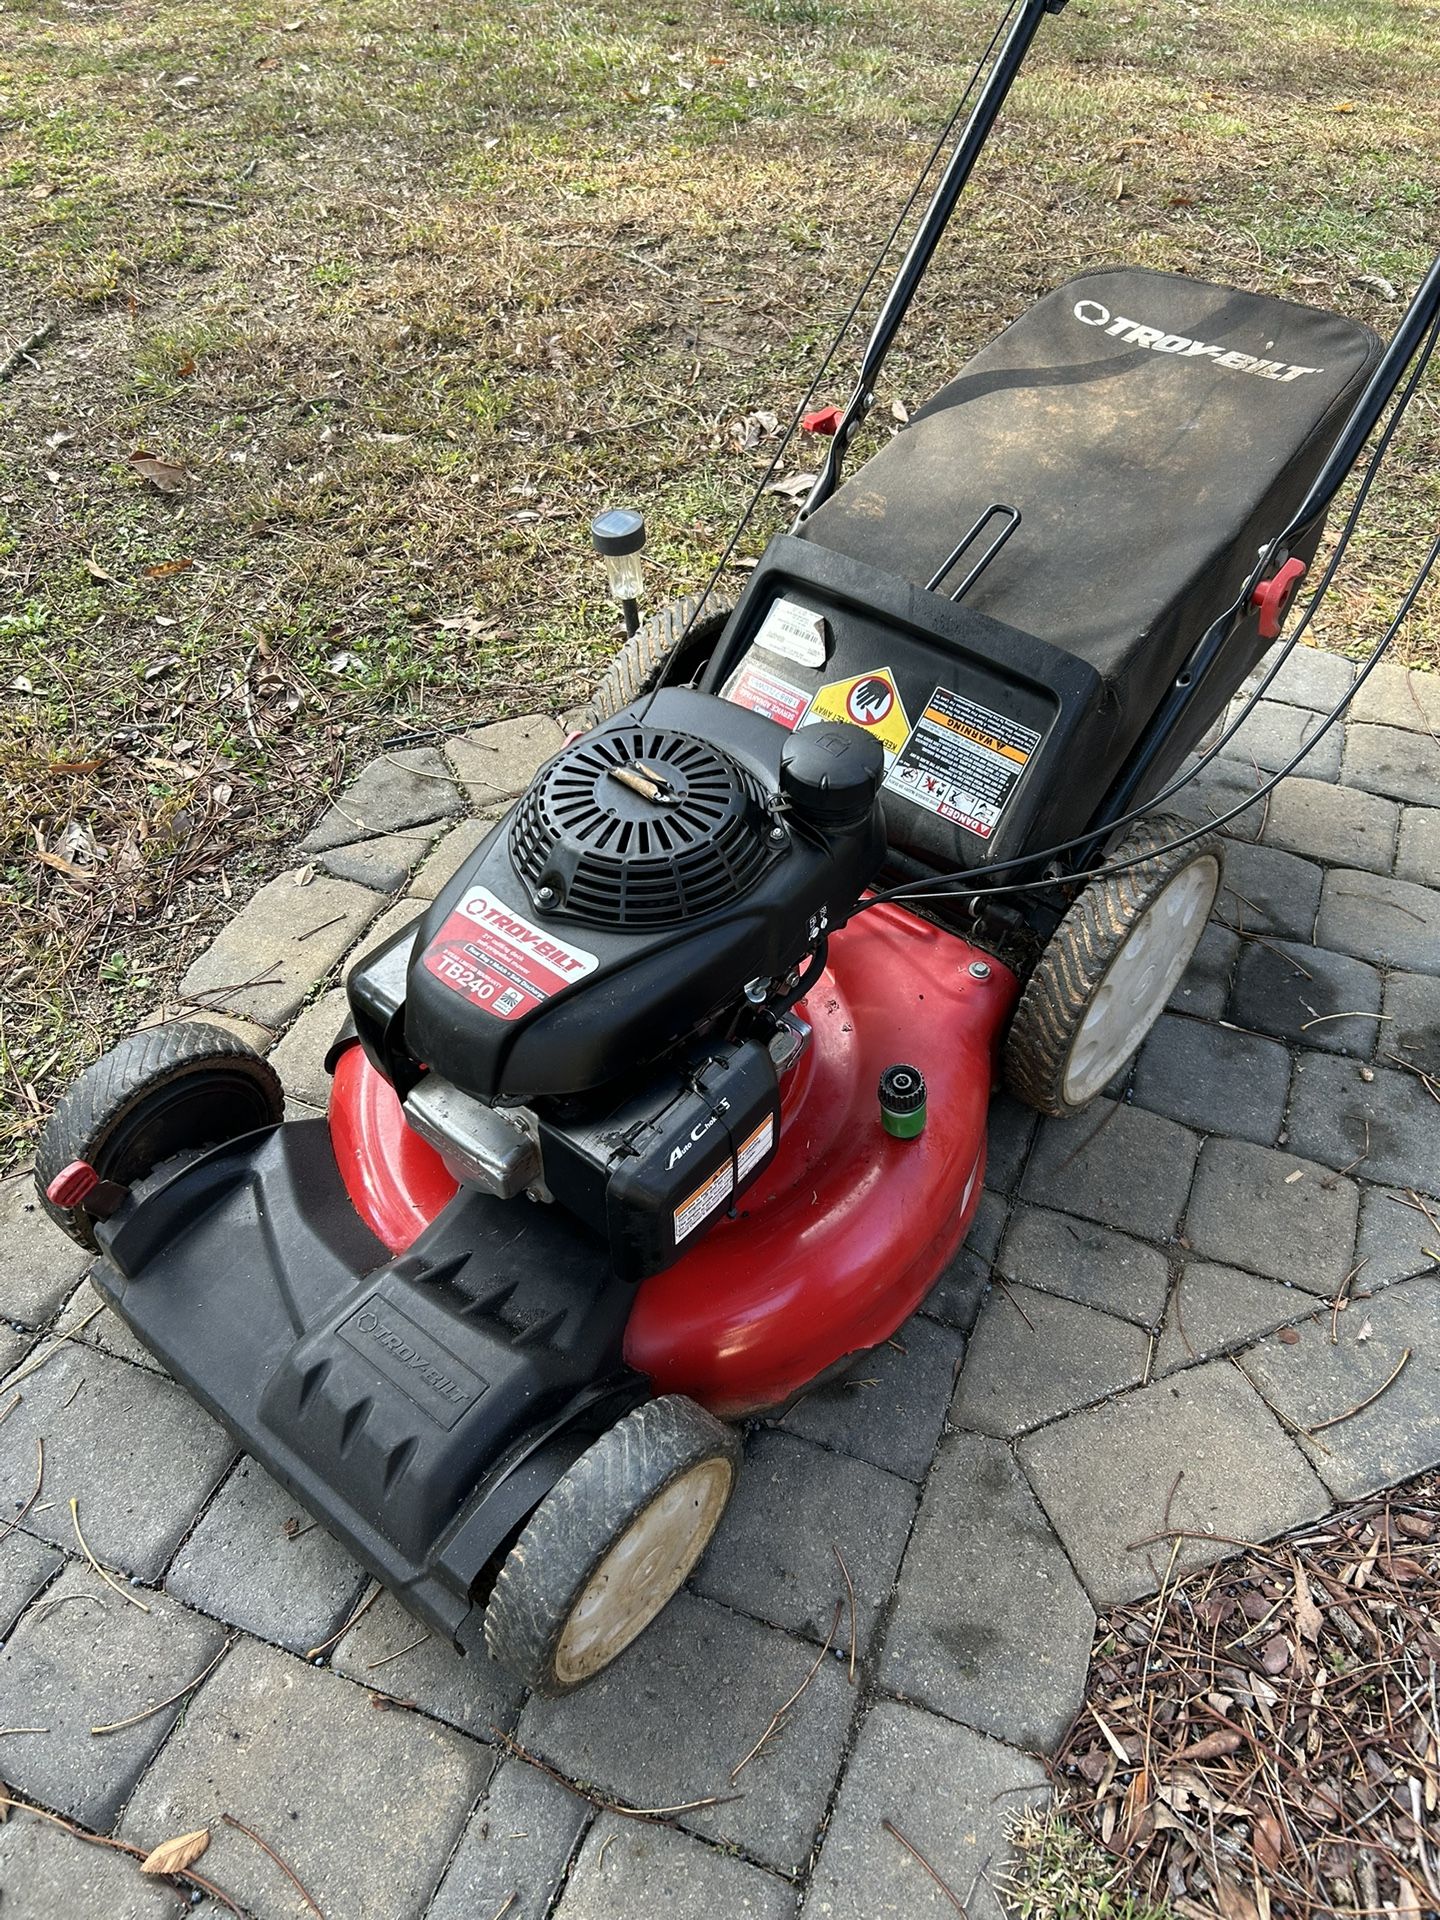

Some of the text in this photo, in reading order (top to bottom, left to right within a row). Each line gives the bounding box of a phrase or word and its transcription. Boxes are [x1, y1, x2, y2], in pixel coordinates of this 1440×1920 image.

[1104, 316, 1318, 382] TROY-BILT
[814, 705, 834, 718] AWAY
[945, 717, 993, 746] WARNING
[939, 804, 980, 829] DANGER
[482, 908, 584, 972] TROY-BILT
[437, 955, 495, 999] TB240
[665, 1146, 693, 1171] Auto
[690, 1116, 720, 1141] Chok
[373, 1324, 470, 1404] TROY-BILT
